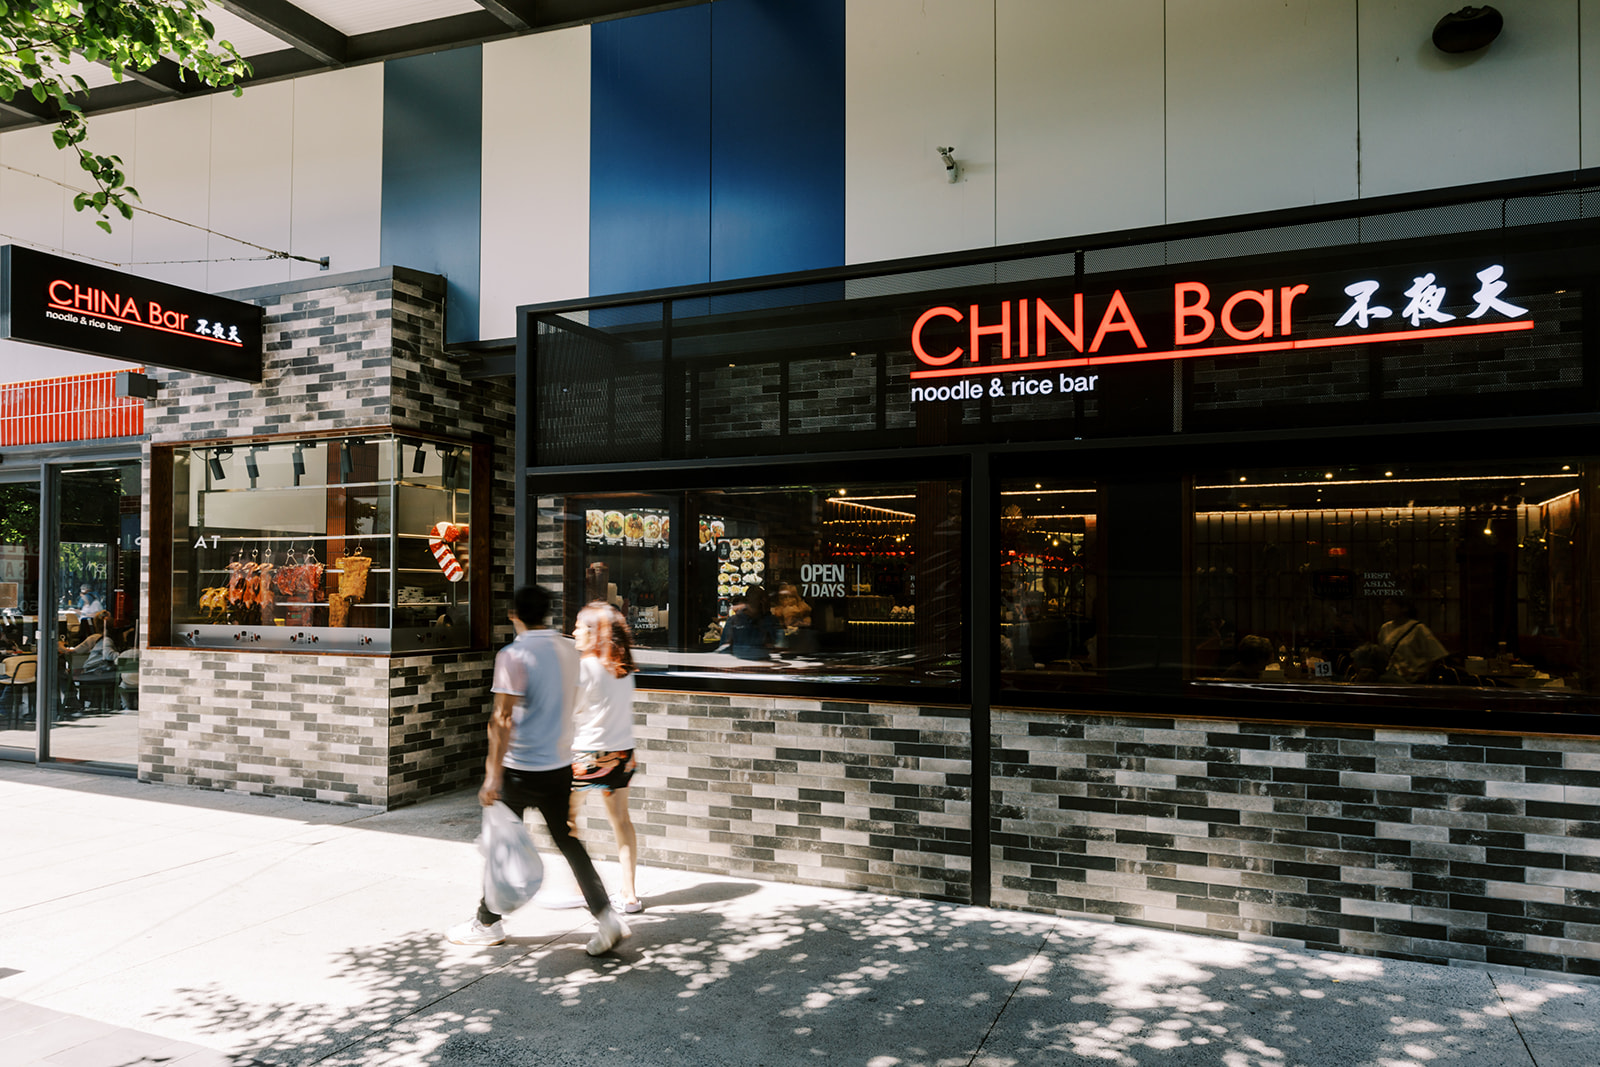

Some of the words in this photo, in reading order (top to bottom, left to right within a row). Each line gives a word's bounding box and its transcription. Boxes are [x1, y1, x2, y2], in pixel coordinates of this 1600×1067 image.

[48, 280, 142, 322] CHINA
[149, 301, 189, 331] Bar
[1334, 264, 1529, 329] 不夜天
[46, 310, 79, 324] noodle
[79, 315, 88, 326] &
[88, 318, 106, 330] rice
[106, 321, 123, 333] bar
[195, 319, 243, 344] 不夜天
[911, 289, 1148, 367] CHINA
[1173, 281, 1310, 346] Bar
[911, 380, 983, 402] noodle
[988, 378, 1005, 397] &
[1011, 376, 1054, 396] rice
[1059, 373, 1099, 393] bar
[800, 563, 845, 583] OPEN
[801, 583, 809, 598] 7
[811, 583, 846, 598] DAYS
[1317, 663, 1329, 675] 19
